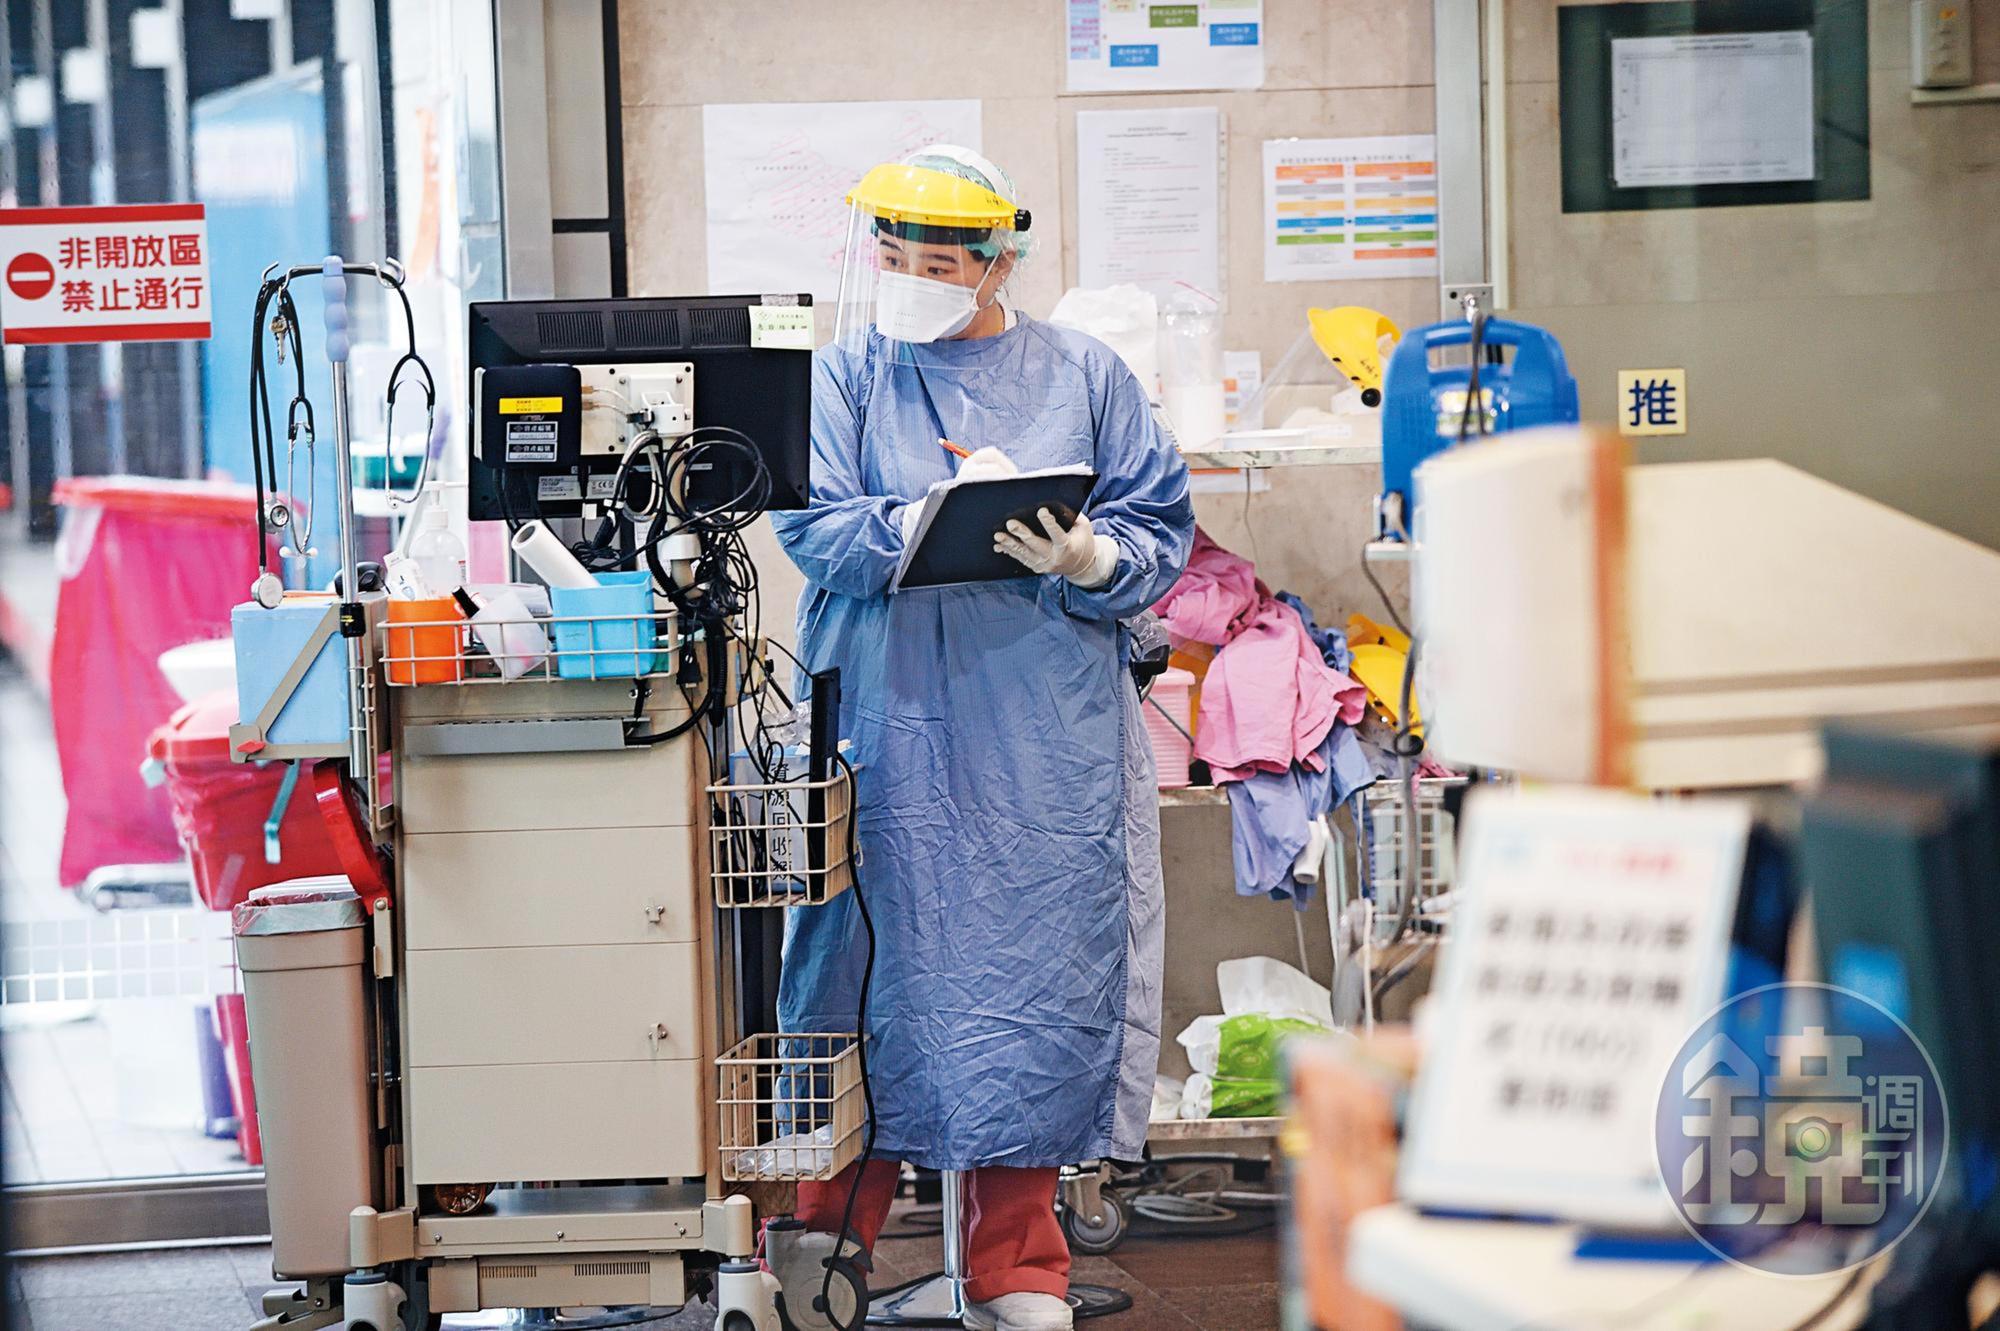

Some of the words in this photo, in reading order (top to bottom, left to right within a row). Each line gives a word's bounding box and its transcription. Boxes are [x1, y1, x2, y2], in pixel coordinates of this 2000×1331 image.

[59, 234, 202, 270] 非開放區
[61, 277, 204, 313] 禁止通行
[1628, 379, 1678, 427] 推
